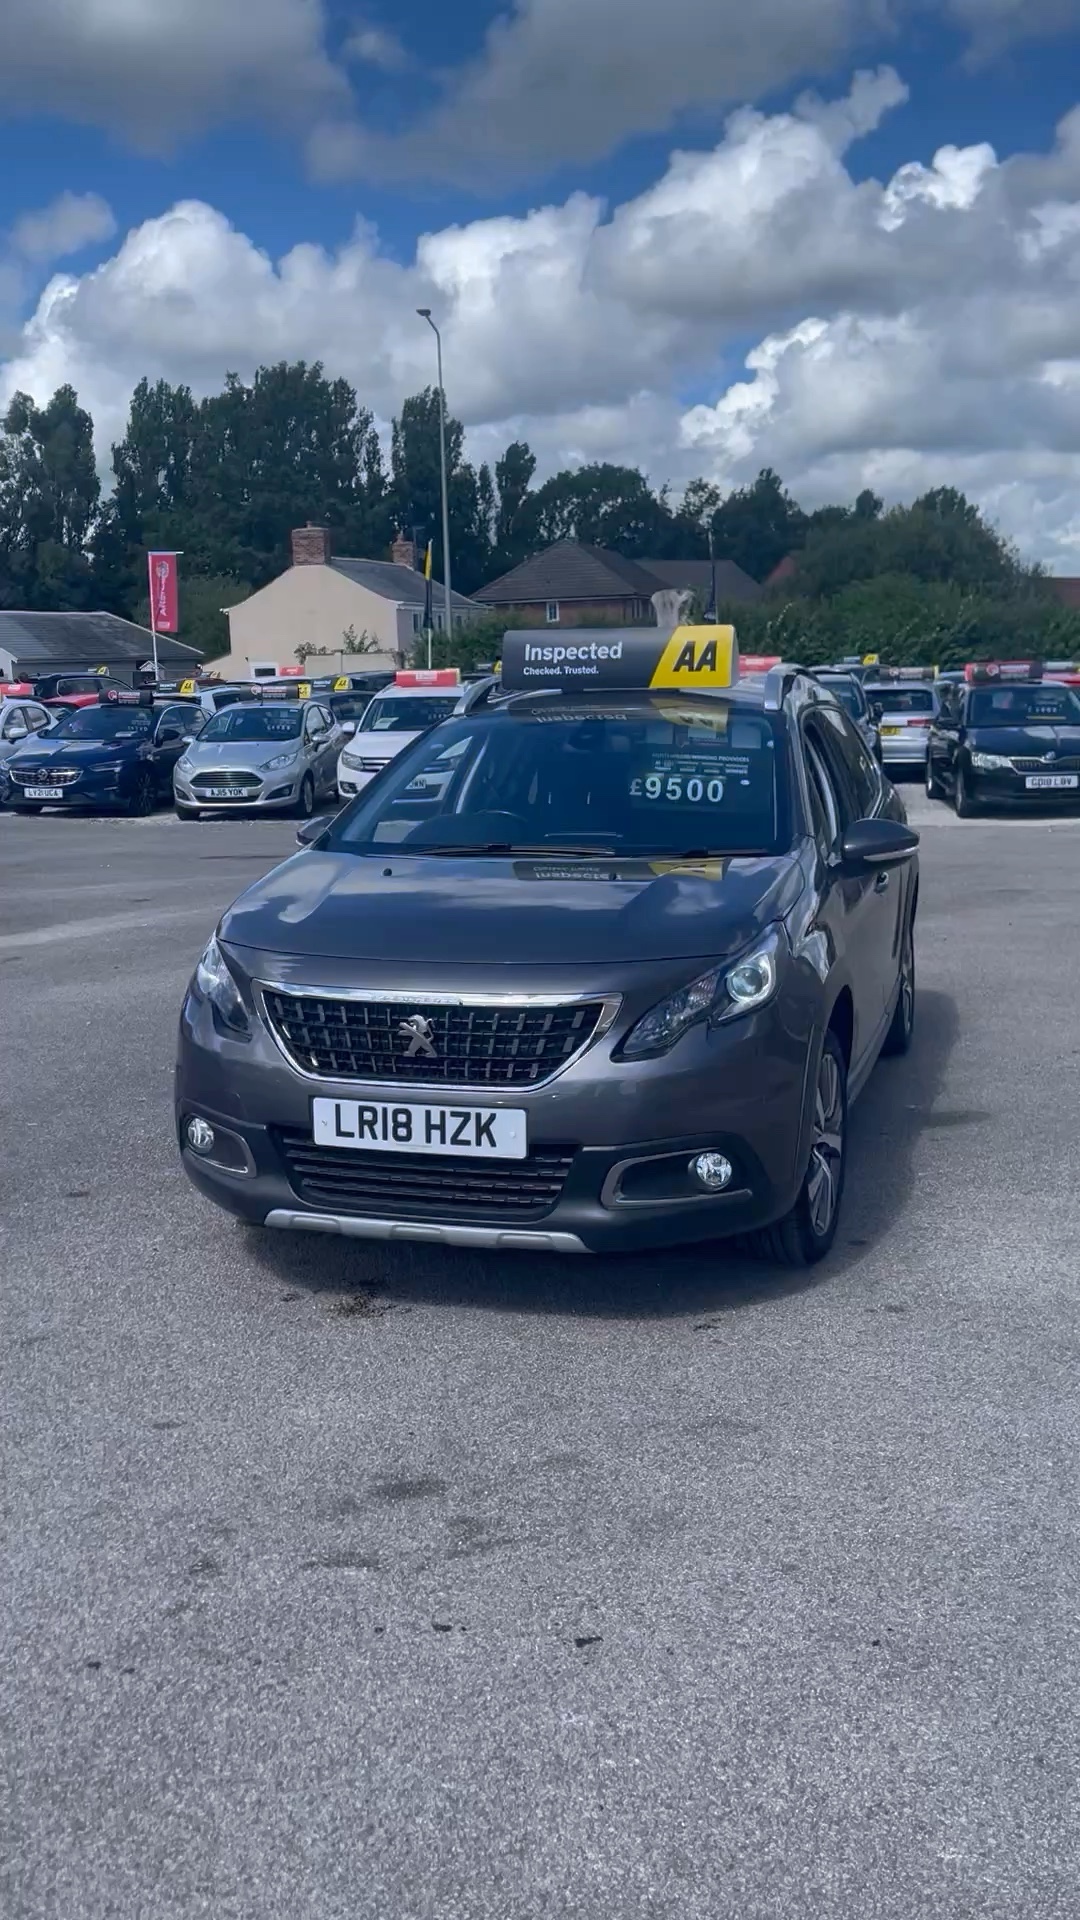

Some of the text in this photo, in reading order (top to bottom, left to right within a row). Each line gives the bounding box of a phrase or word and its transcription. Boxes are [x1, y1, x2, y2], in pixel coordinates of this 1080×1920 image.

[525, 641, 623, 663] Inspected
[672, 640, 718, 673] AA
[523, 665, 600, 676] Checked. Trusted.
[210, 788, 244, 797] AJ15 YOK
[629, 776, 724, 803] £9500
[334, 1103, 498, 1148] LR18 HZK
